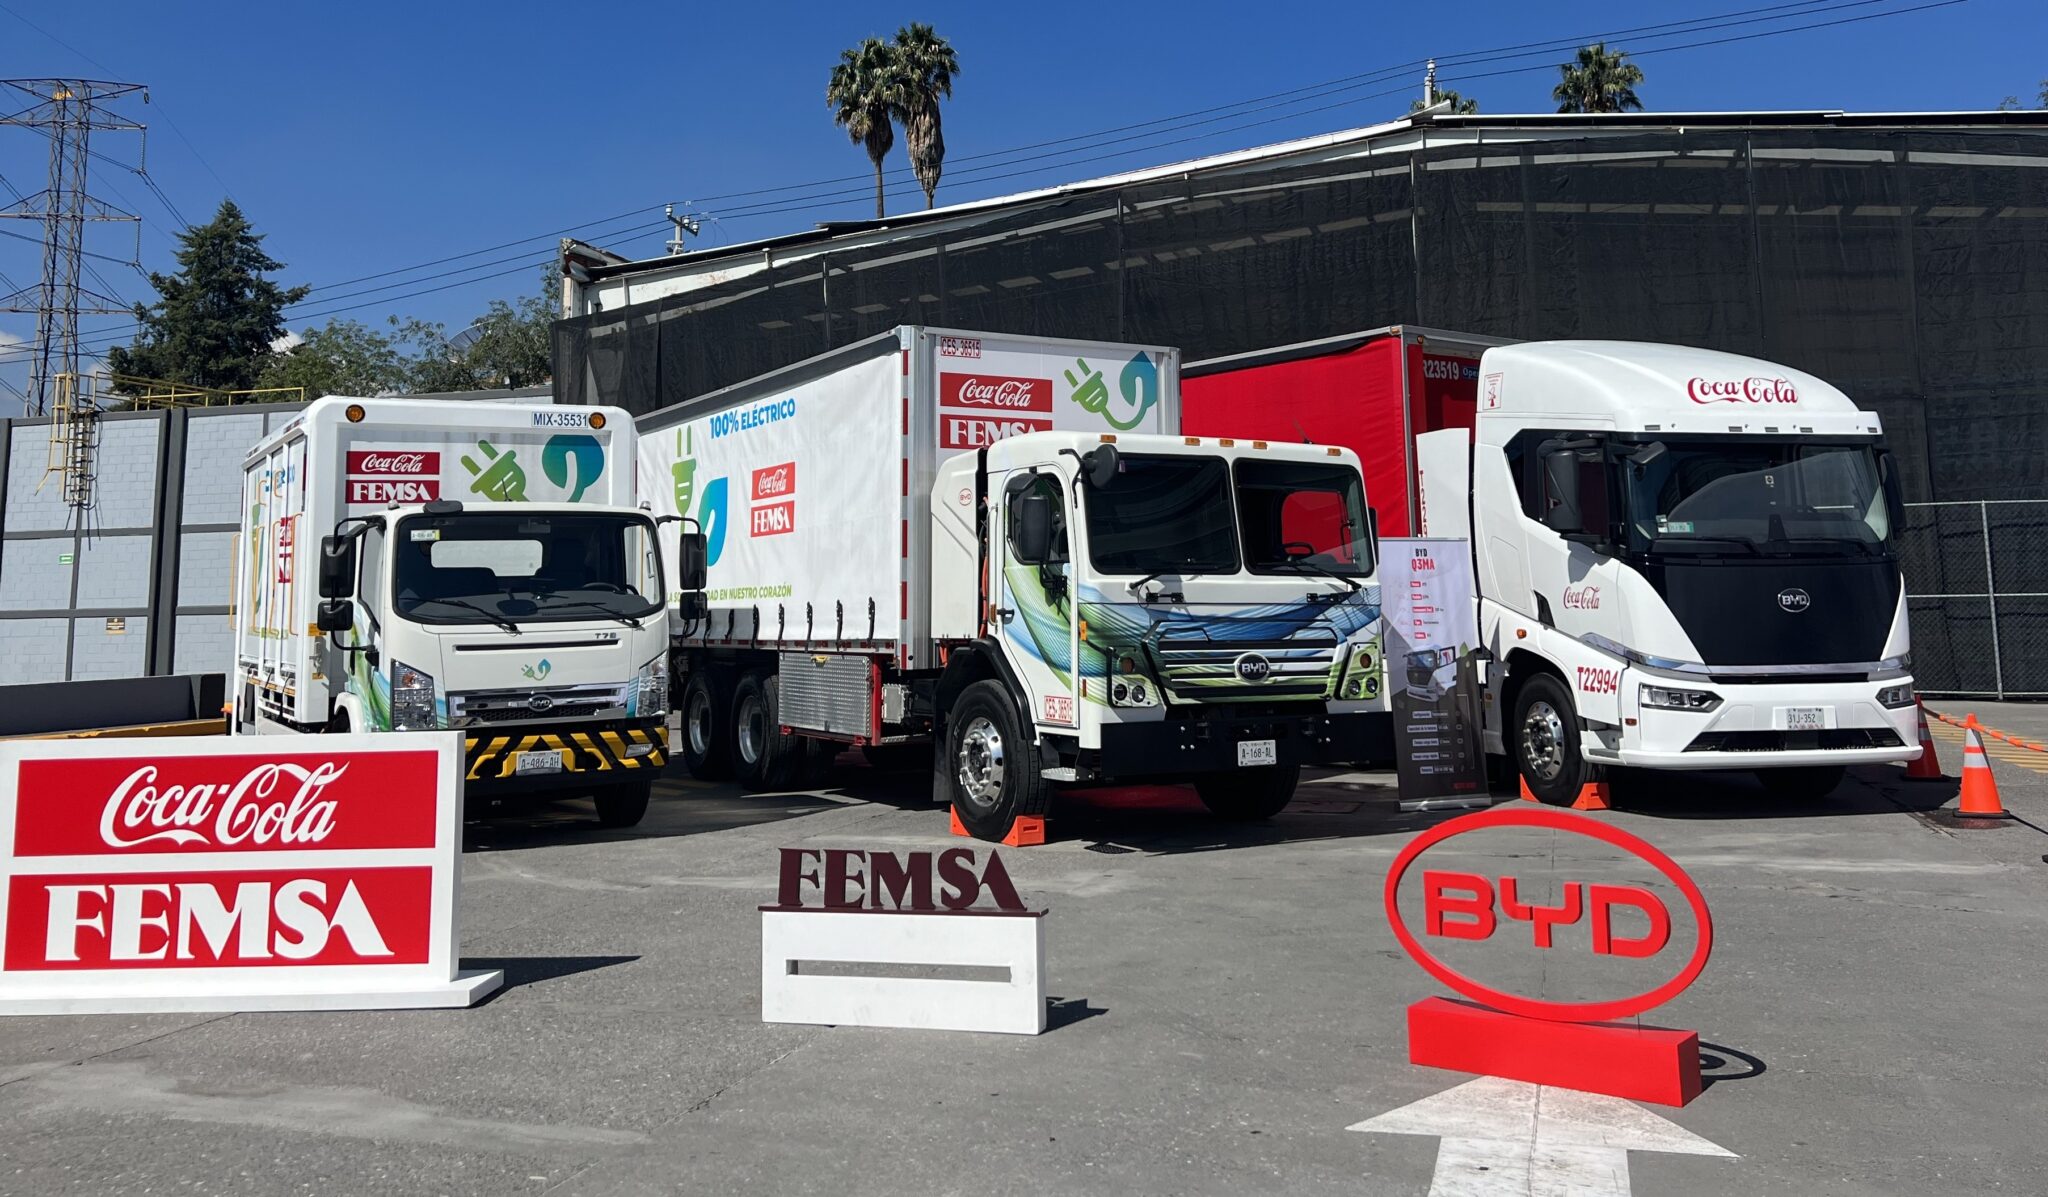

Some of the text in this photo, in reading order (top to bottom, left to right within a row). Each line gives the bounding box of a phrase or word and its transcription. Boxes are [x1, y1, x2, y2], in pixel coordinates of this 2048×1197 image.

[959, 379, 1035, 407] Coca-Cola
[1687, 377, 1799, 404] Coca-Cola
[533, 413, 587, 427] MIX-35531
[710, 398, 795, 439] 100% ELÉCTRICO
[949, 418, 1036, 446] FEMS
[361, 454, 426, 472] Coca-Cola
[353, 482, 433, 501] FEMSA
[758, 467, 787, 496] Coca-Cola
[753, 506, 791, 533] FEMSA
[1411, 558, 1435, 572] Q3MA
[1415, 548, 1428, 557] BYD
[720, 588, 728, 600] EN
[729, 586, 757, 600] NUESTRO
[759, 582, 792, 598] CORAZÓN
[1563, 586, 1600, 609] Coca-Cola
[1781, 594, 1807, 605] BYD
[1242, 663, 1266, 673] BYD
[1577, 666, 1619, 695] T22994
[521, 756, 559, 769] A-486-AH
[1241, 747, 1273, 759] A-168-AL
[99, 760, 350, 847] Coca-Cola
[778, 847, 1027, 910] FEMSA
[44, 878, 395, 961] FEMSA
[1423, 870, 1671, 958] BYD
